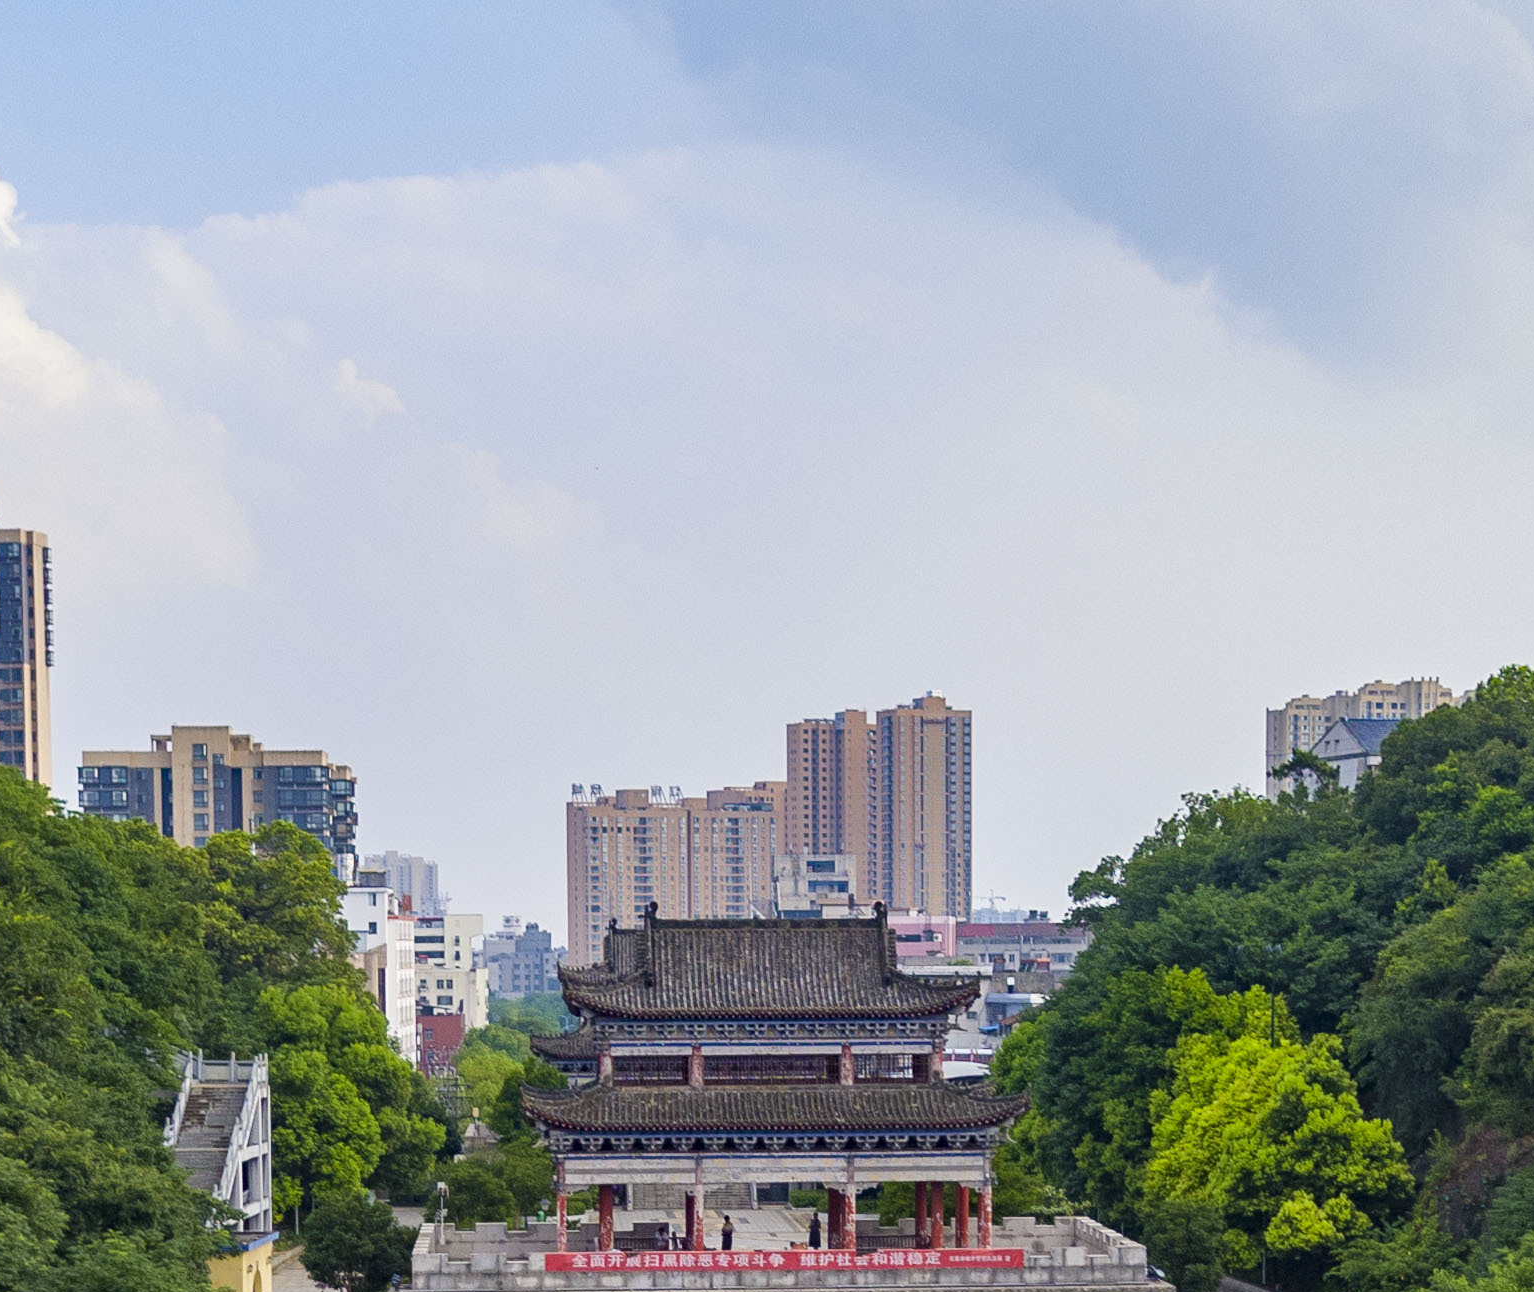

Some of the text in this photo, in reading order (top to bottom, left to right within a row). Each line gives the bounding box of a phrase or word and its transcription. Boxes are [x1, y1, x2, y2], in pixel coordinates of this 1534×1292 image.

[571, 1253, 785, 1268] 全面开展扫黑除恶专项斗争
[800, 1252, 941, 1267] 维护社会和谐稳定
